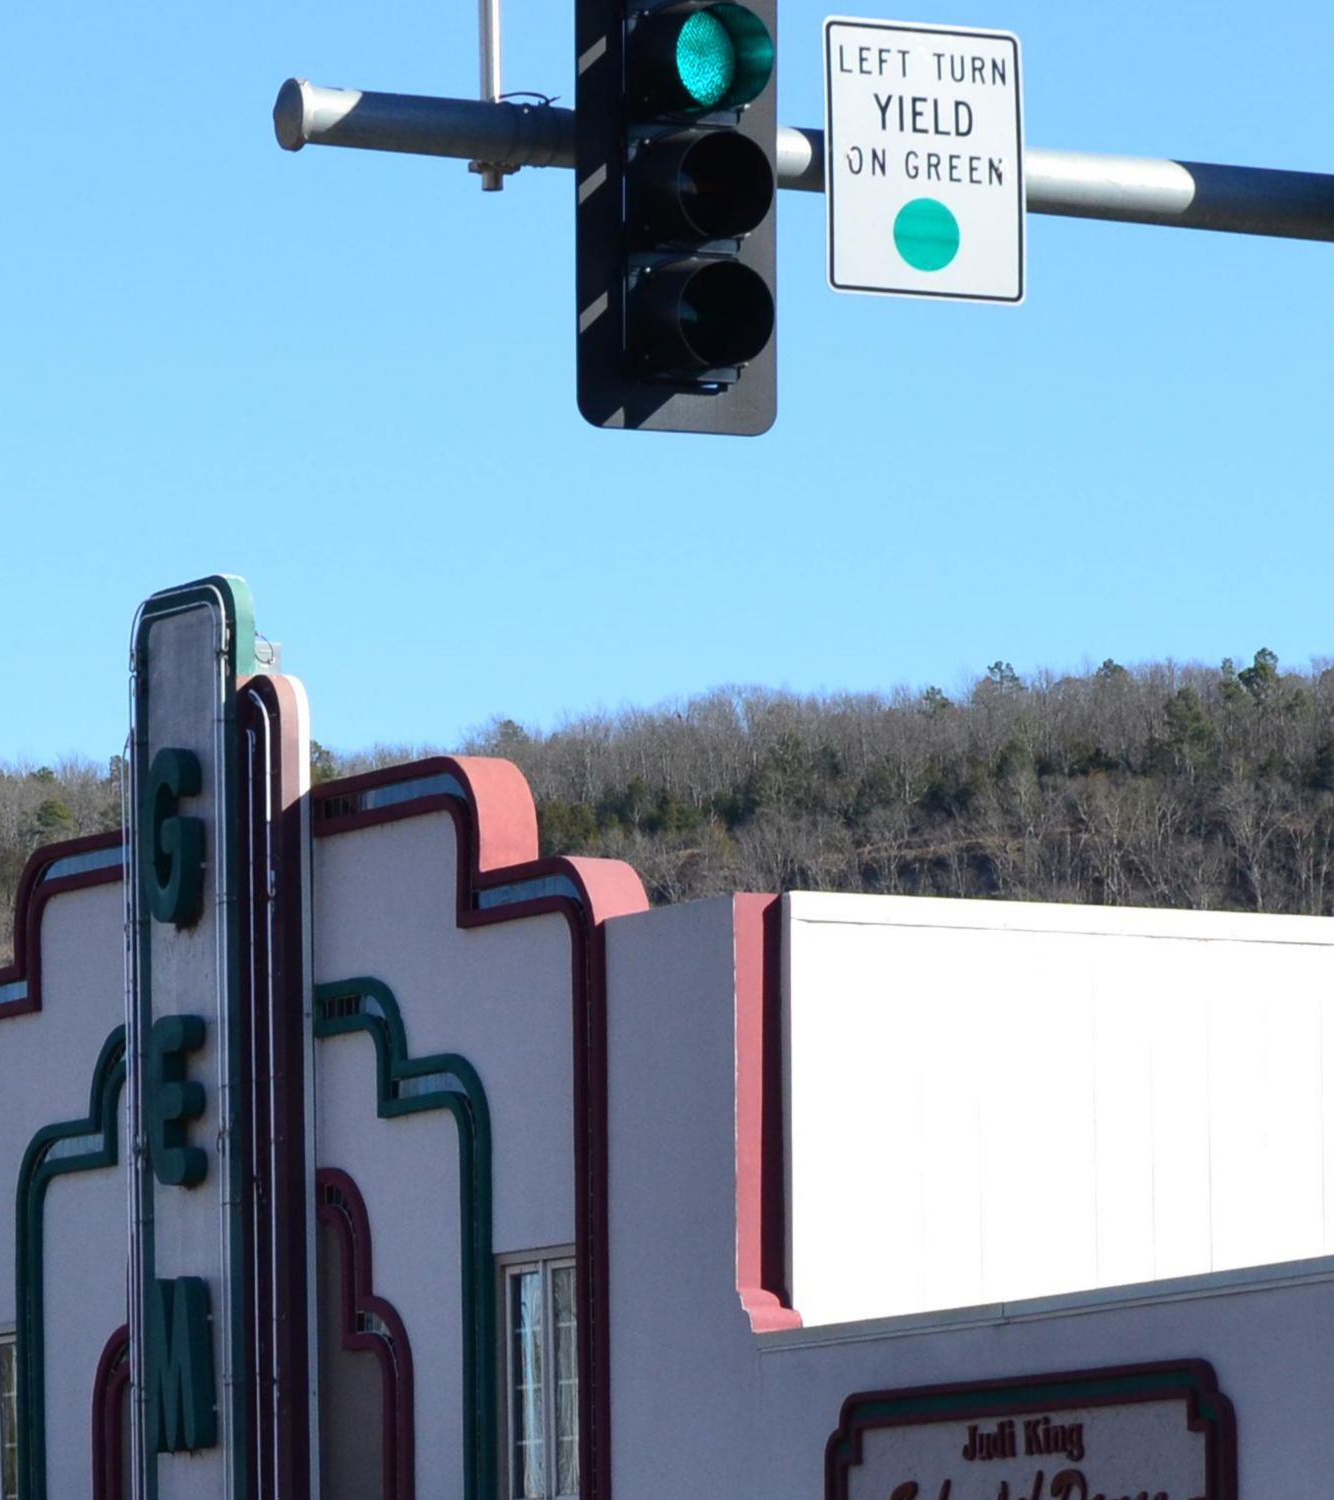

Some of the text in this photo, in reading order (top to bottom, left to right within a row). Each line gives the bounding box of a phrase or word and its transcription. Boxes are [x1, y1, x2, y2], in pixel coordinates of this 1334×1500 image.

[839, 44, 1007, 86] LEFT TURN
[873, 93, 973, 137] YIELD
[846, 146, 1004, 187] ON GREEN
[145, 746, 219, 1455] GEM
[962, 1415, 1086, 1462] Judi King
